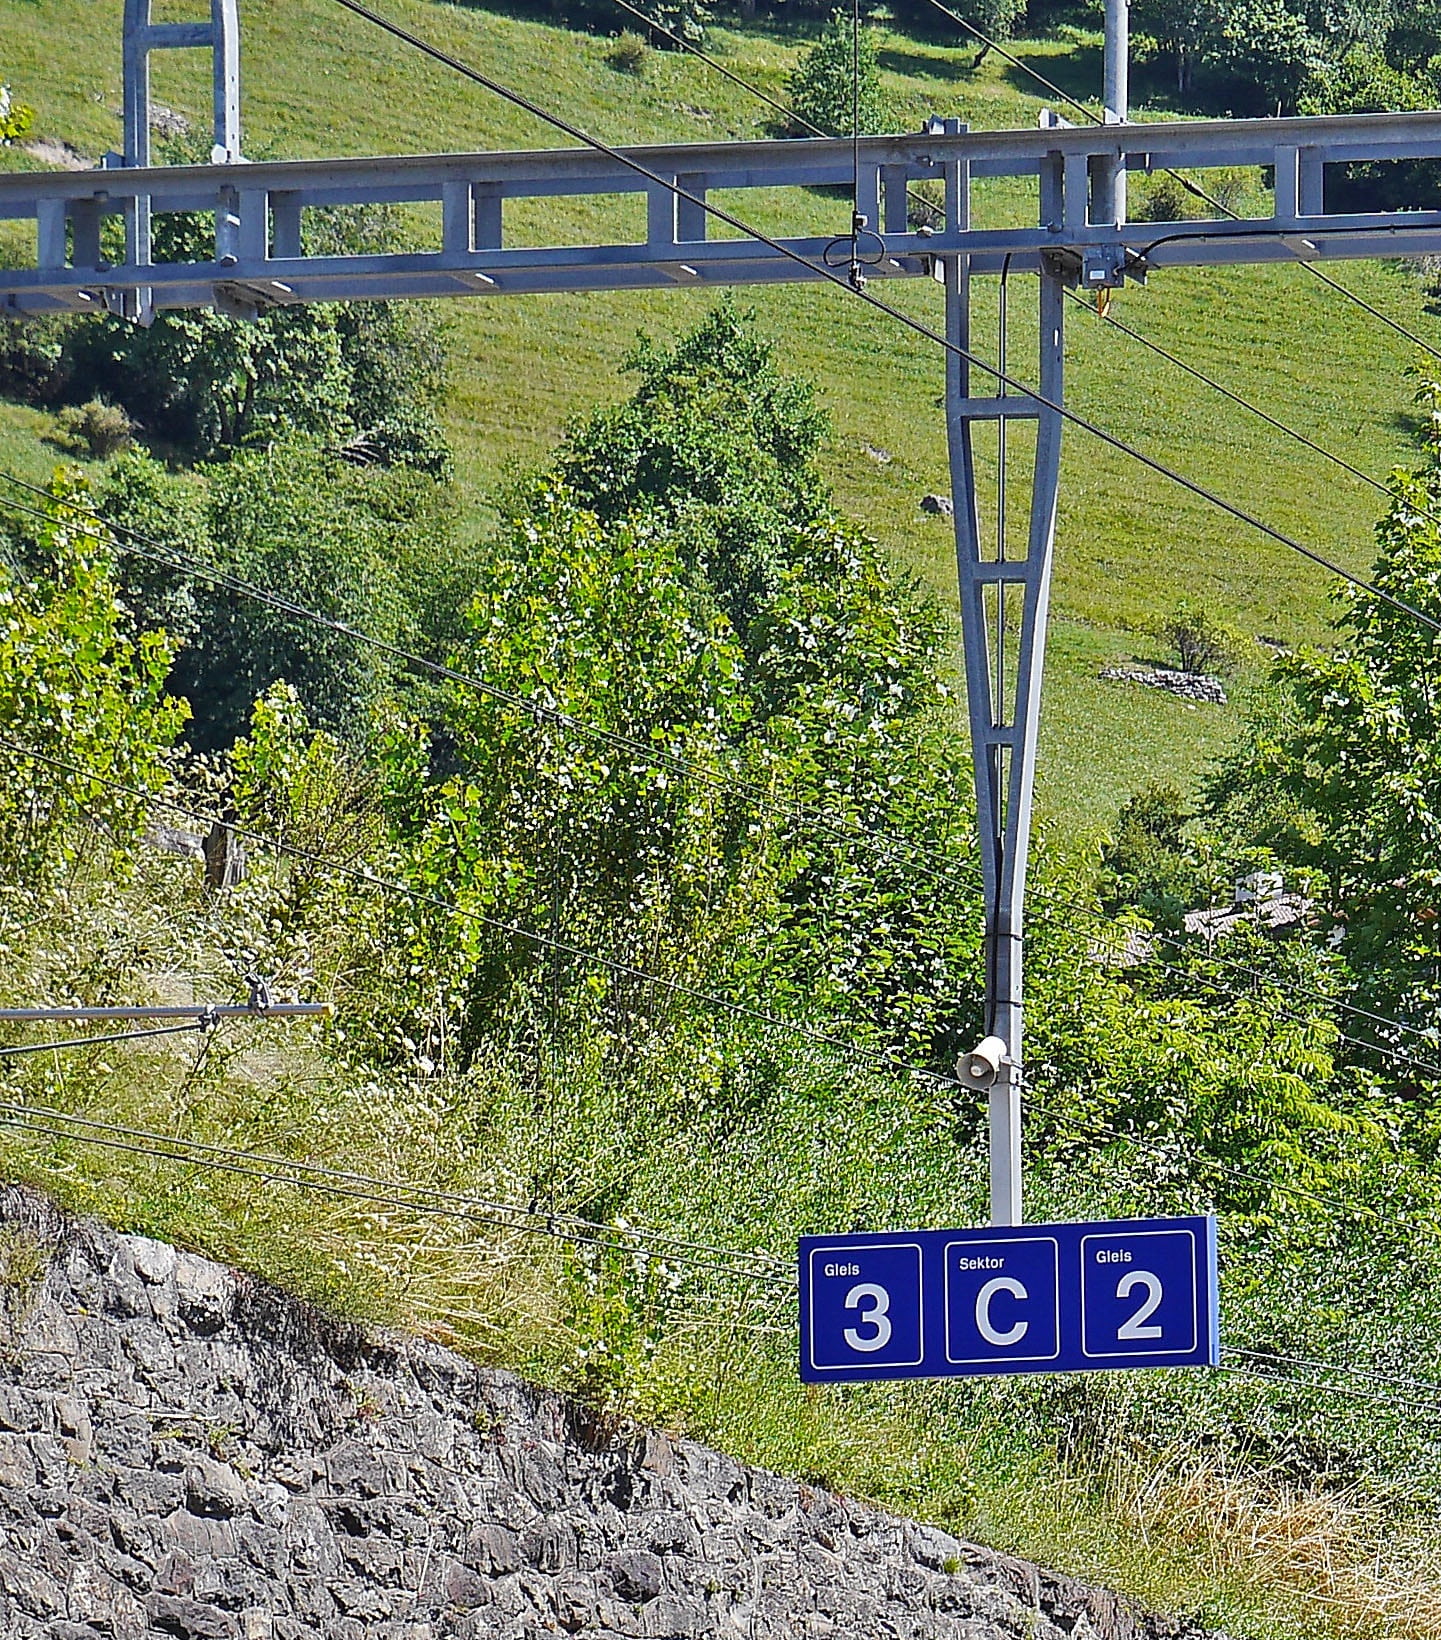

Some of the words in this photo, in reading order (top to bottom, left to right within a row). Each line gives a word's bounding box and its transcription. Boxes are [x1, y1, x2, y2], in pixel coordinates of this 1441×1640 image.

[824, 1262, 860, 1277] Gleis
[959, 1256, 1004, 1271] Sektor
[1095, 1248, 1132, 1264] Gleis
[843, 1283, 892, 1352] 3
[975, 1277, 1029, 1346] C
[1115, 1270, 1163, 1340] 2
